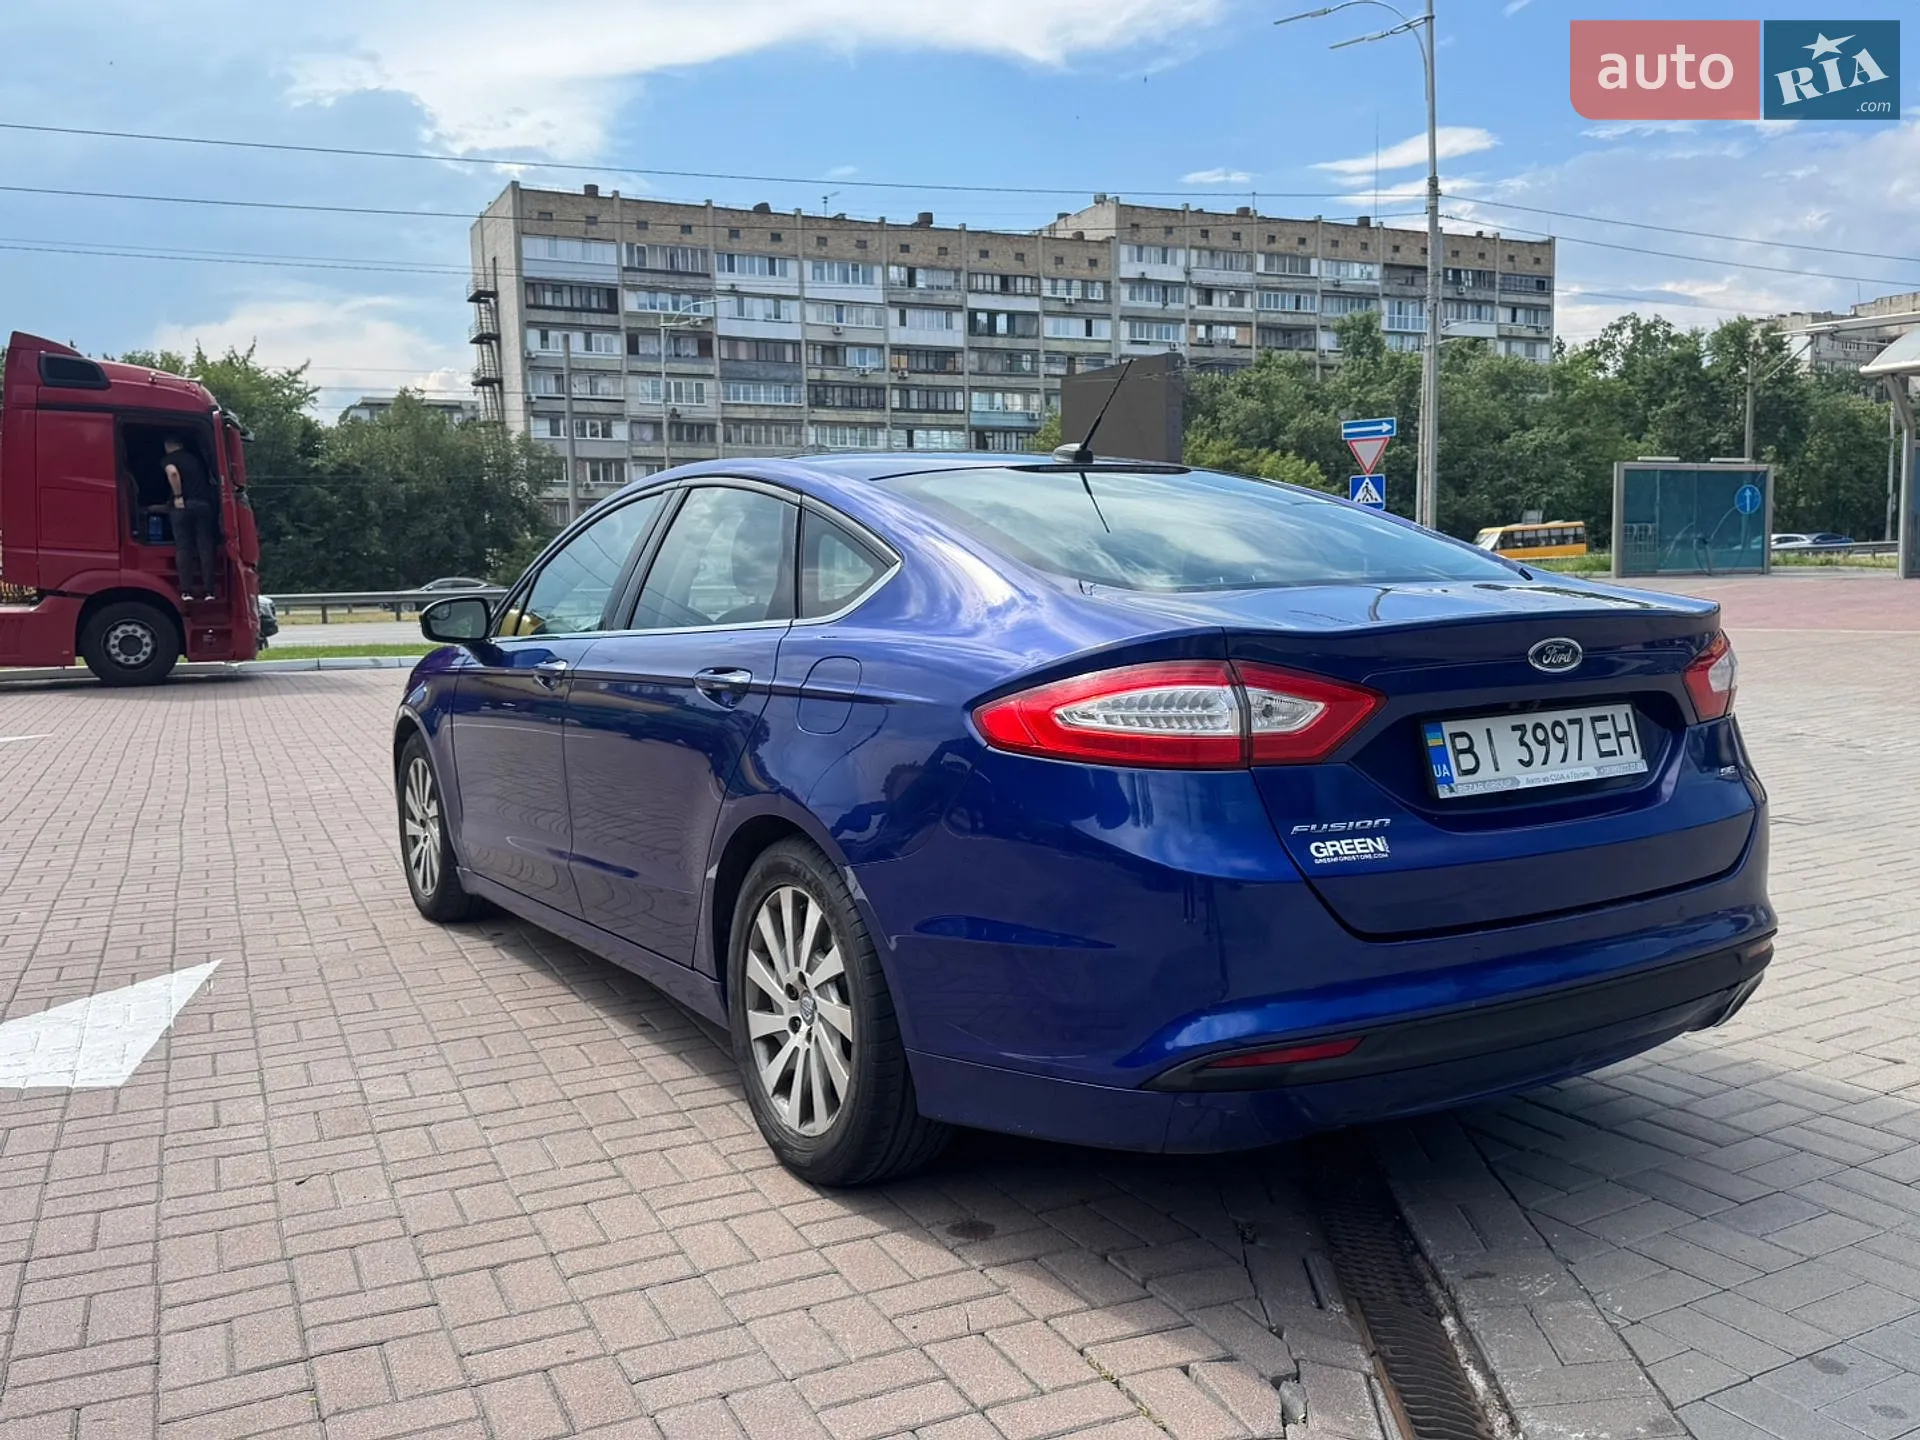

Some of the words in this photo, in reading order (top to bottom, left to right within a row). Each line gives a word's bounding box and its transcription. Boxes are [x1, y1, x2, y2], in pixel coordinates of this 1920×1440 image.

[1542, 645, 1572, 664] Ford
[1449, 727, 1500, 777] BI
[1511, 717, 1583, 768] 3997
[1590, 712, 1637, 758] EH
[1433, 763, 1450, 778] UA
[1290, 818, 1391, 835] FUSION
[1309, 837, 1385, 858] GREEN
